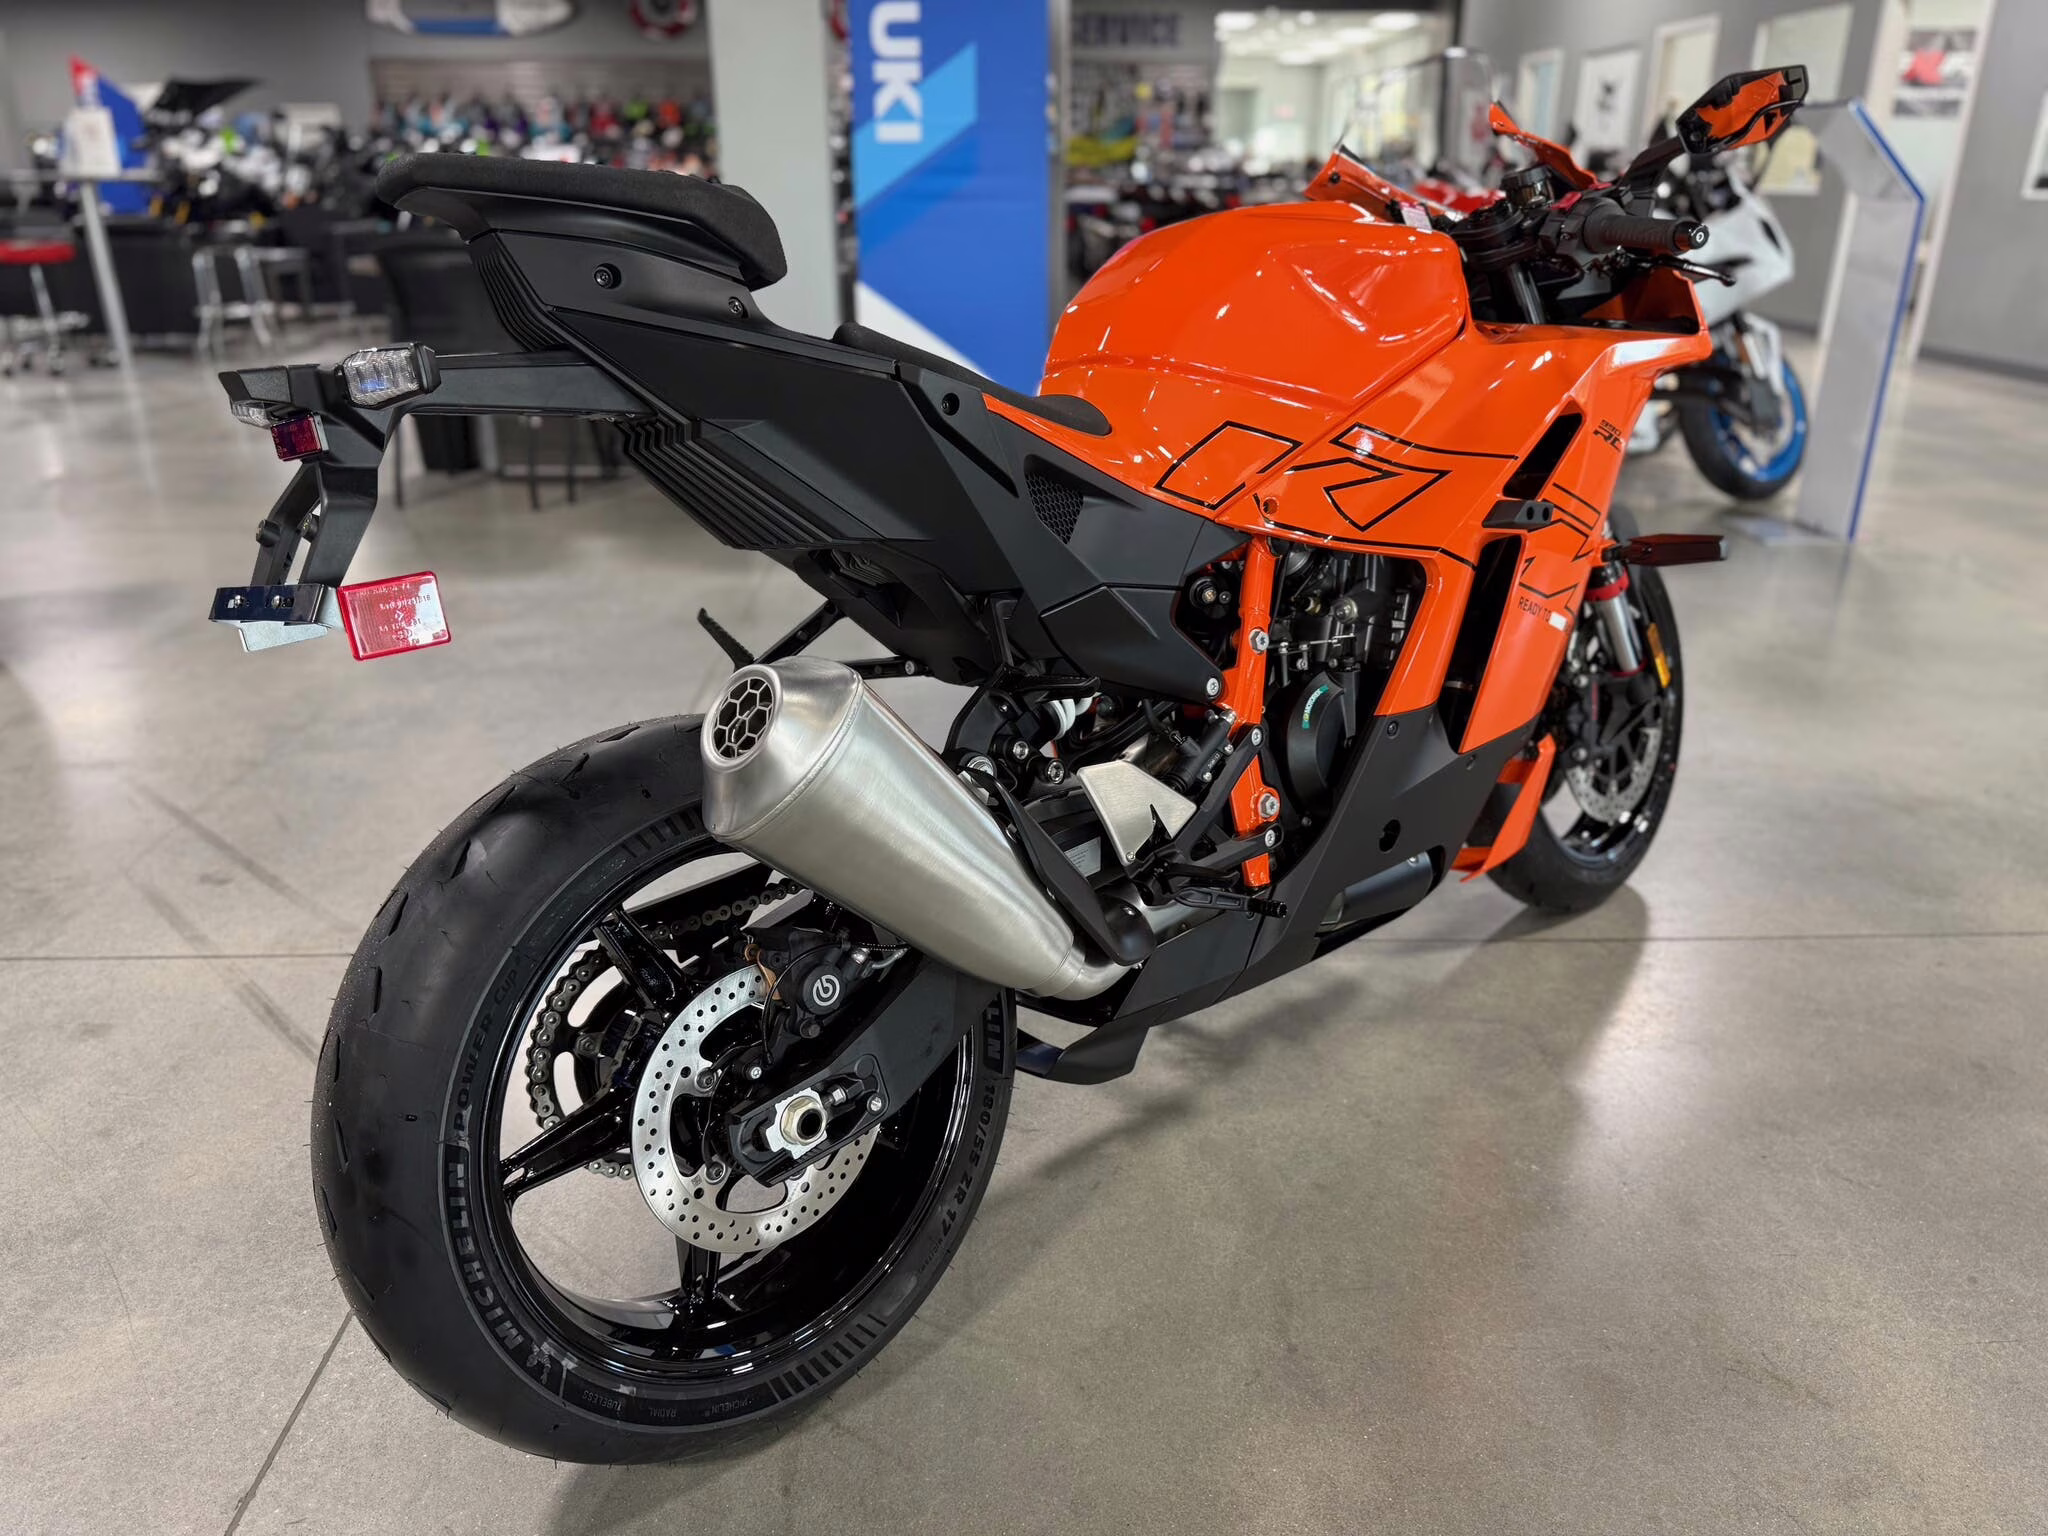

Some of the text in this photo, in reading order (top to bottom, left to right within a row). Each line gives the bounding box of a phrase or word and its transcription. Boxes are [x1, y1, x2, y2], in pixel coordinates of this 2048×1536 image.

[1518, 596, 1544, 616] READY
[453, 1012, 494, 1133] POWER
[969, 1085, 996, 1168] 180/55
[953, 1171, 974, 1205] ZR
[941, 1208, 958, 1237] 17
[448, 1162, 525, 1350] MICHELIN
[582, 1390, 622, 1412] TUBELESS
